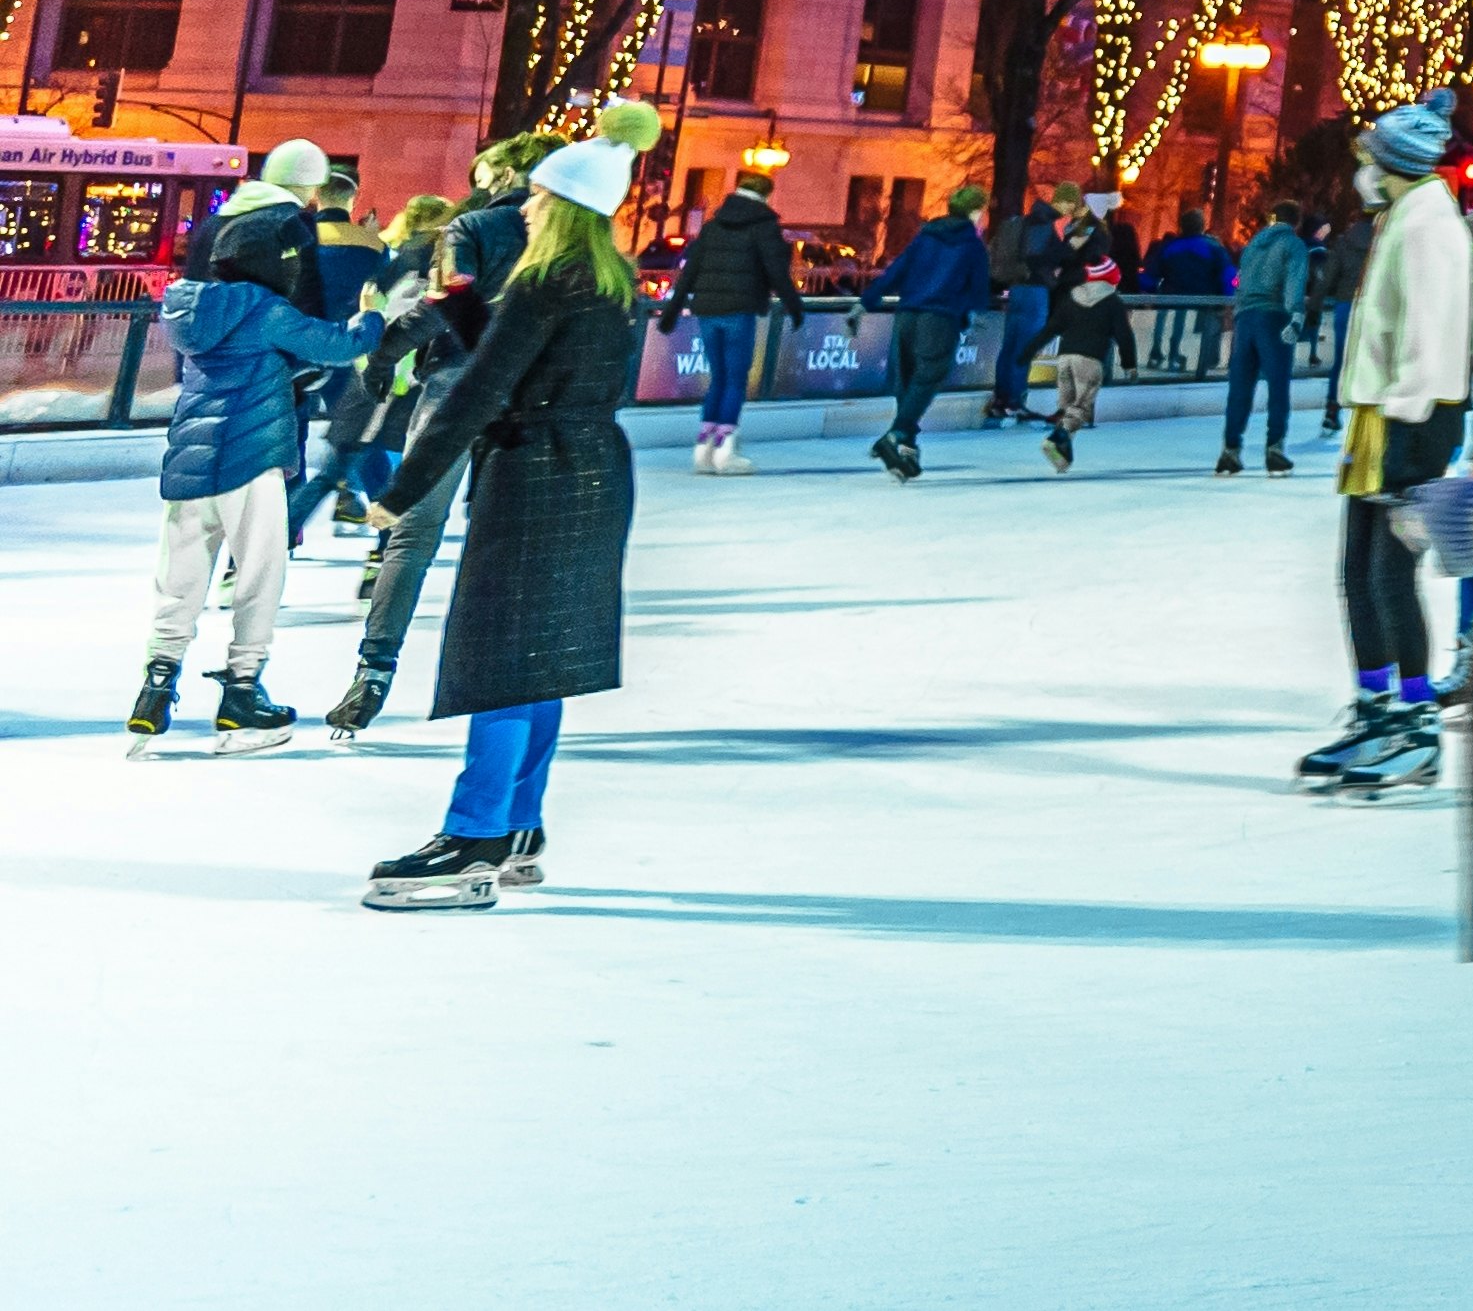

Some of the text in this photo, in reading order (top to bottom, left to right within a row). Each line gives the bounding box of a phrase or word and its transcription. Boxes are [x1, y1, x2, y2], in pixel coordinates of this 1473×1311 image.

[29, 148, 56, 163] Air
[60, 148, 117, 167] Hybrid
[122, 150, 153, 166] Bus
[808, 349, 860, 371] LOCAL
